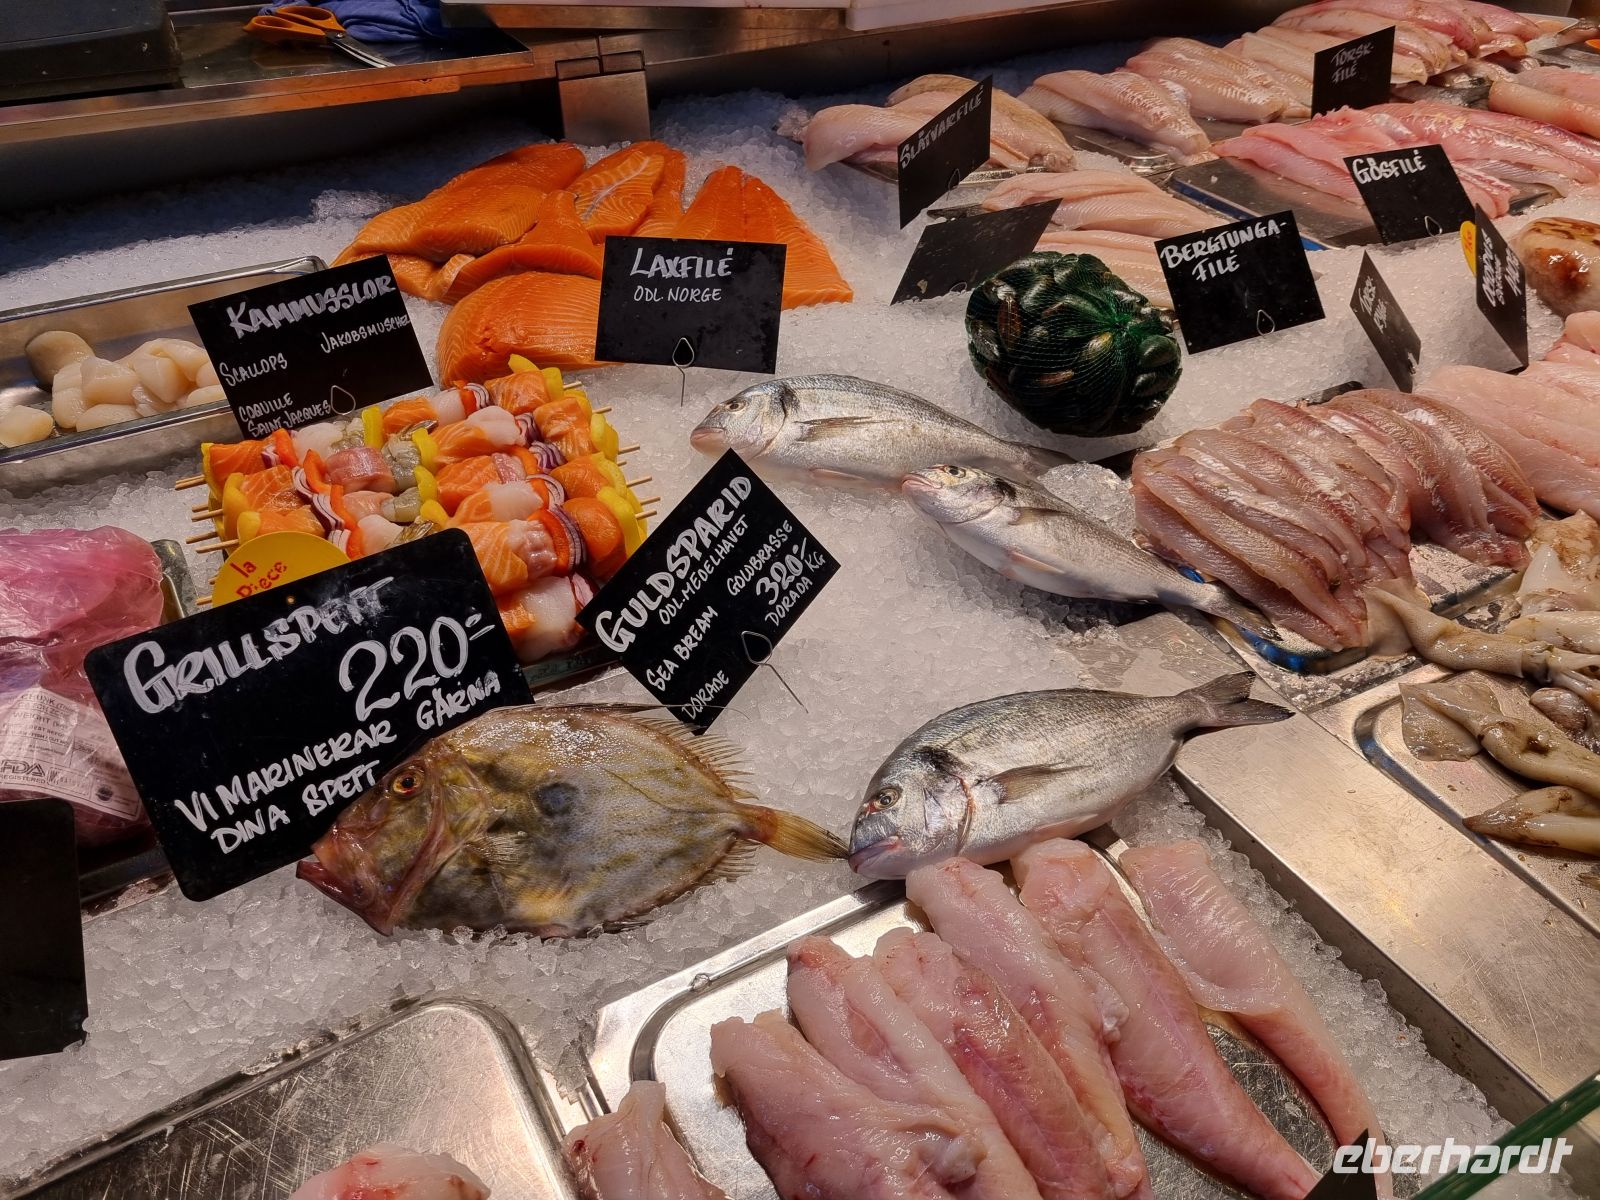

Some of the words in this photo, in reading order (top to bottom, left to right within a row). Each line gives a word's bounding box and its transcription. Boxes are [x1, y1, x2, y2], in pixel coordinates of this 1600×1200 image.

[630, 247, 734, 279] LAXFILÉ
[1159, 219, 1287, 269] BERGTUNGA-
[226, 274, 396, 340] KAMMUSSLOR
[667, 286, 722, 303] NORGE
[219, 352, 288, 387] SCALLOPS
[595, 476, 752, 652] GULDSPARID
[764, 576, 814, 627] DORADA
[645, 658, 680, 691] SEA
[673, 605, 719, 661] BREAM
[681, 669, 730, 721] DORADE
[1, 759, 46, 777] FDA
[217, 719, 398, 806] MARINERAR
[210, 808, 291, 854] DINA
[301, 759, 381, 817] SPETT
